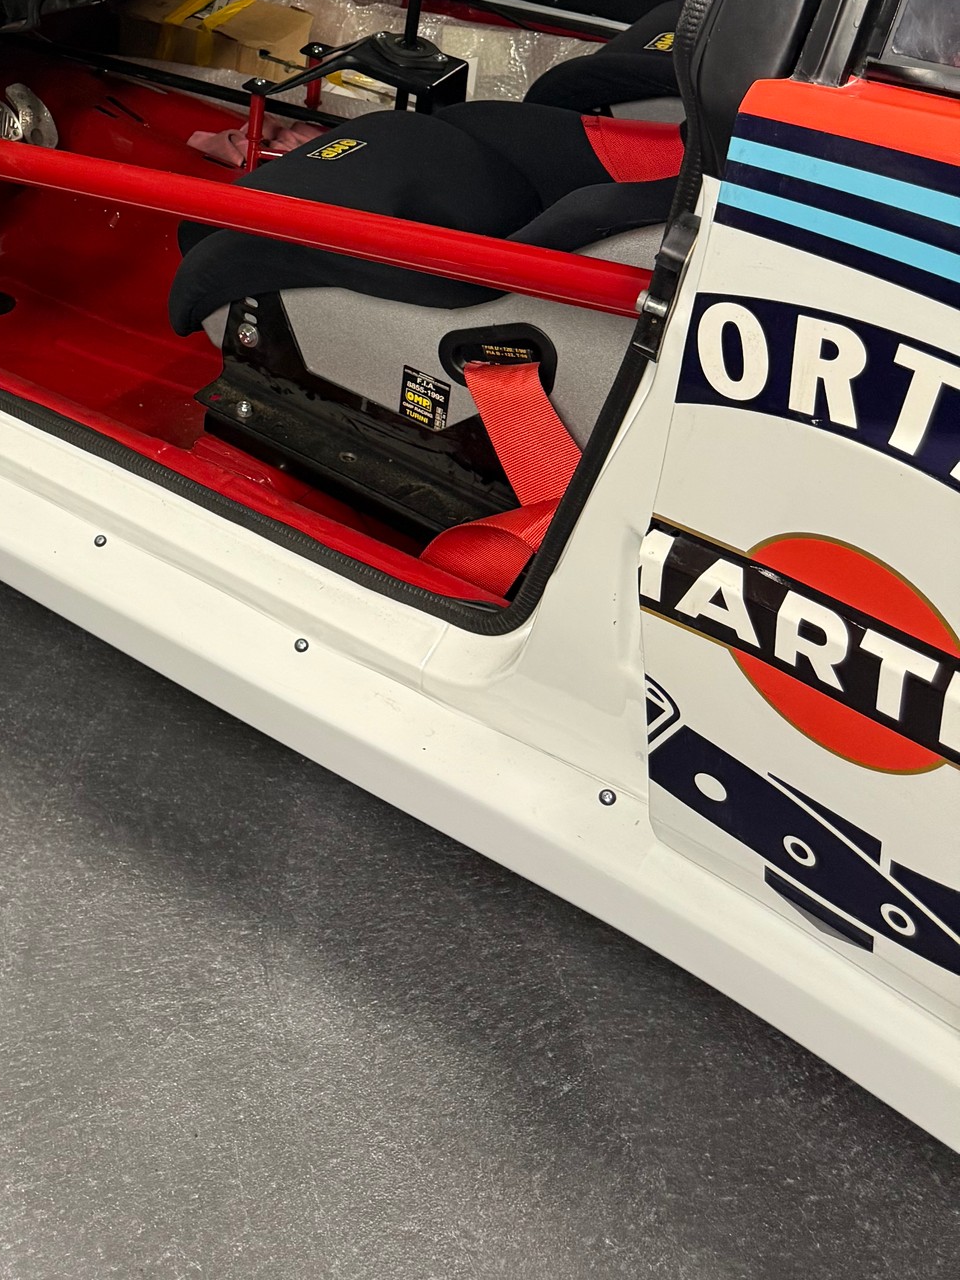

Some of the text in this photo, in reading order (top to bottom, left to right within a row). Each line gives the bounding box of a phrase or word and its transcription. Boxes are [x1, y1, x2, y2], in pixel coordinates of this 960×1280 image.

[320, 140, 357, 158] OMP
[416, 377, 436, 391] F.I.A.
[697, 301, 960, 482] ORT
[407, 391, 430, 407] OMP
